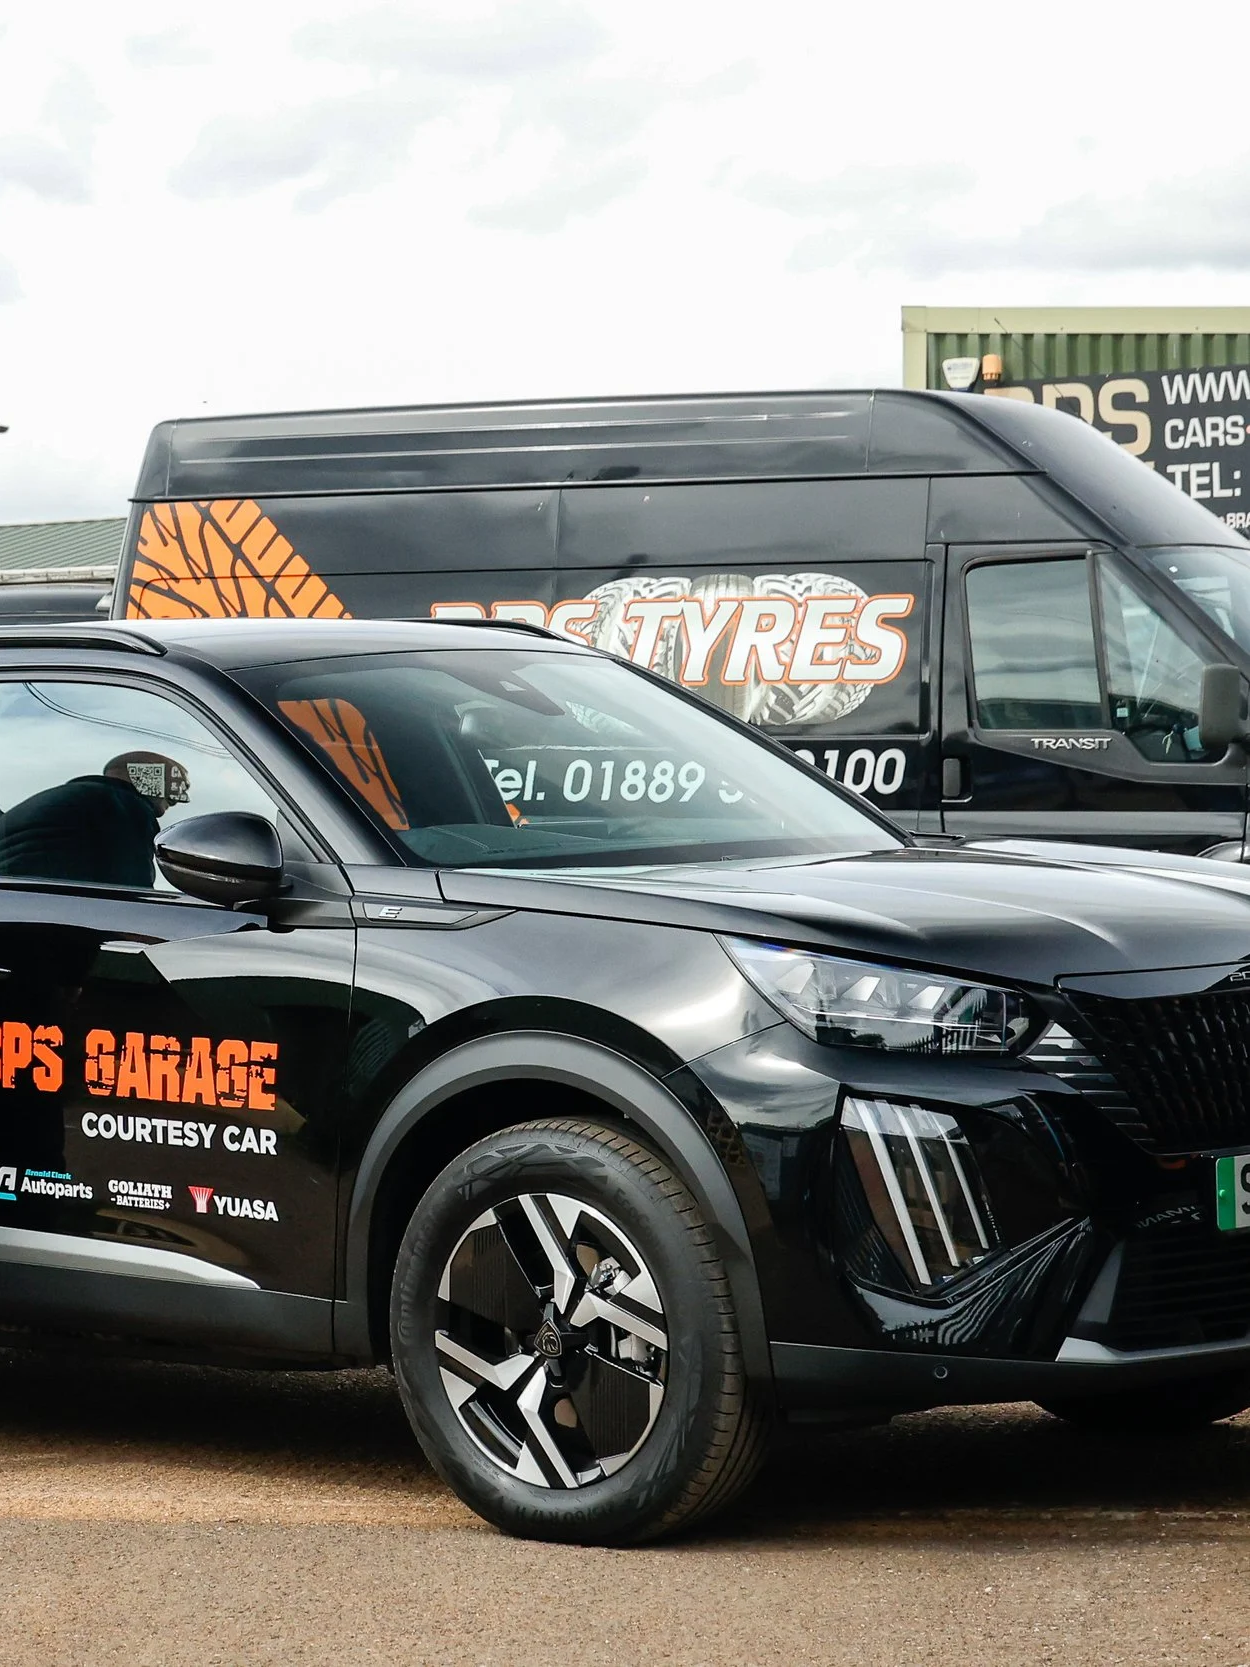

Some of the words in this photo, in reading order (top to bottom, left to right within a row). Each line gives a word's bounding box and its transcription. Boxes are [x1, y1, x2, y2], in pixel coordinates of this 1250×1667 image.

[1164, 414, 1246, 451] CARS
[1165, 461, 1242, 501] TEL:
[623, 592, 916, 687] TYRES
[1030, 737, 1112, 750] TRANSIT
[562, 758, 707, 804] 01889
[84, 1028, 279, 1111] GARAGE
[81, 1111, 217, 1150] COURTESY
[222, 1125, 279, 1156] CAR
[20, 1176, 94, 1200] Autoparts
[24, 1168, 51, 1179] Arnold
[51, 1171, 72, 1181] Clark
[107, 1179, 173, 1200] GOLIATH
[213, 1194, 280, 1222] YUASA
